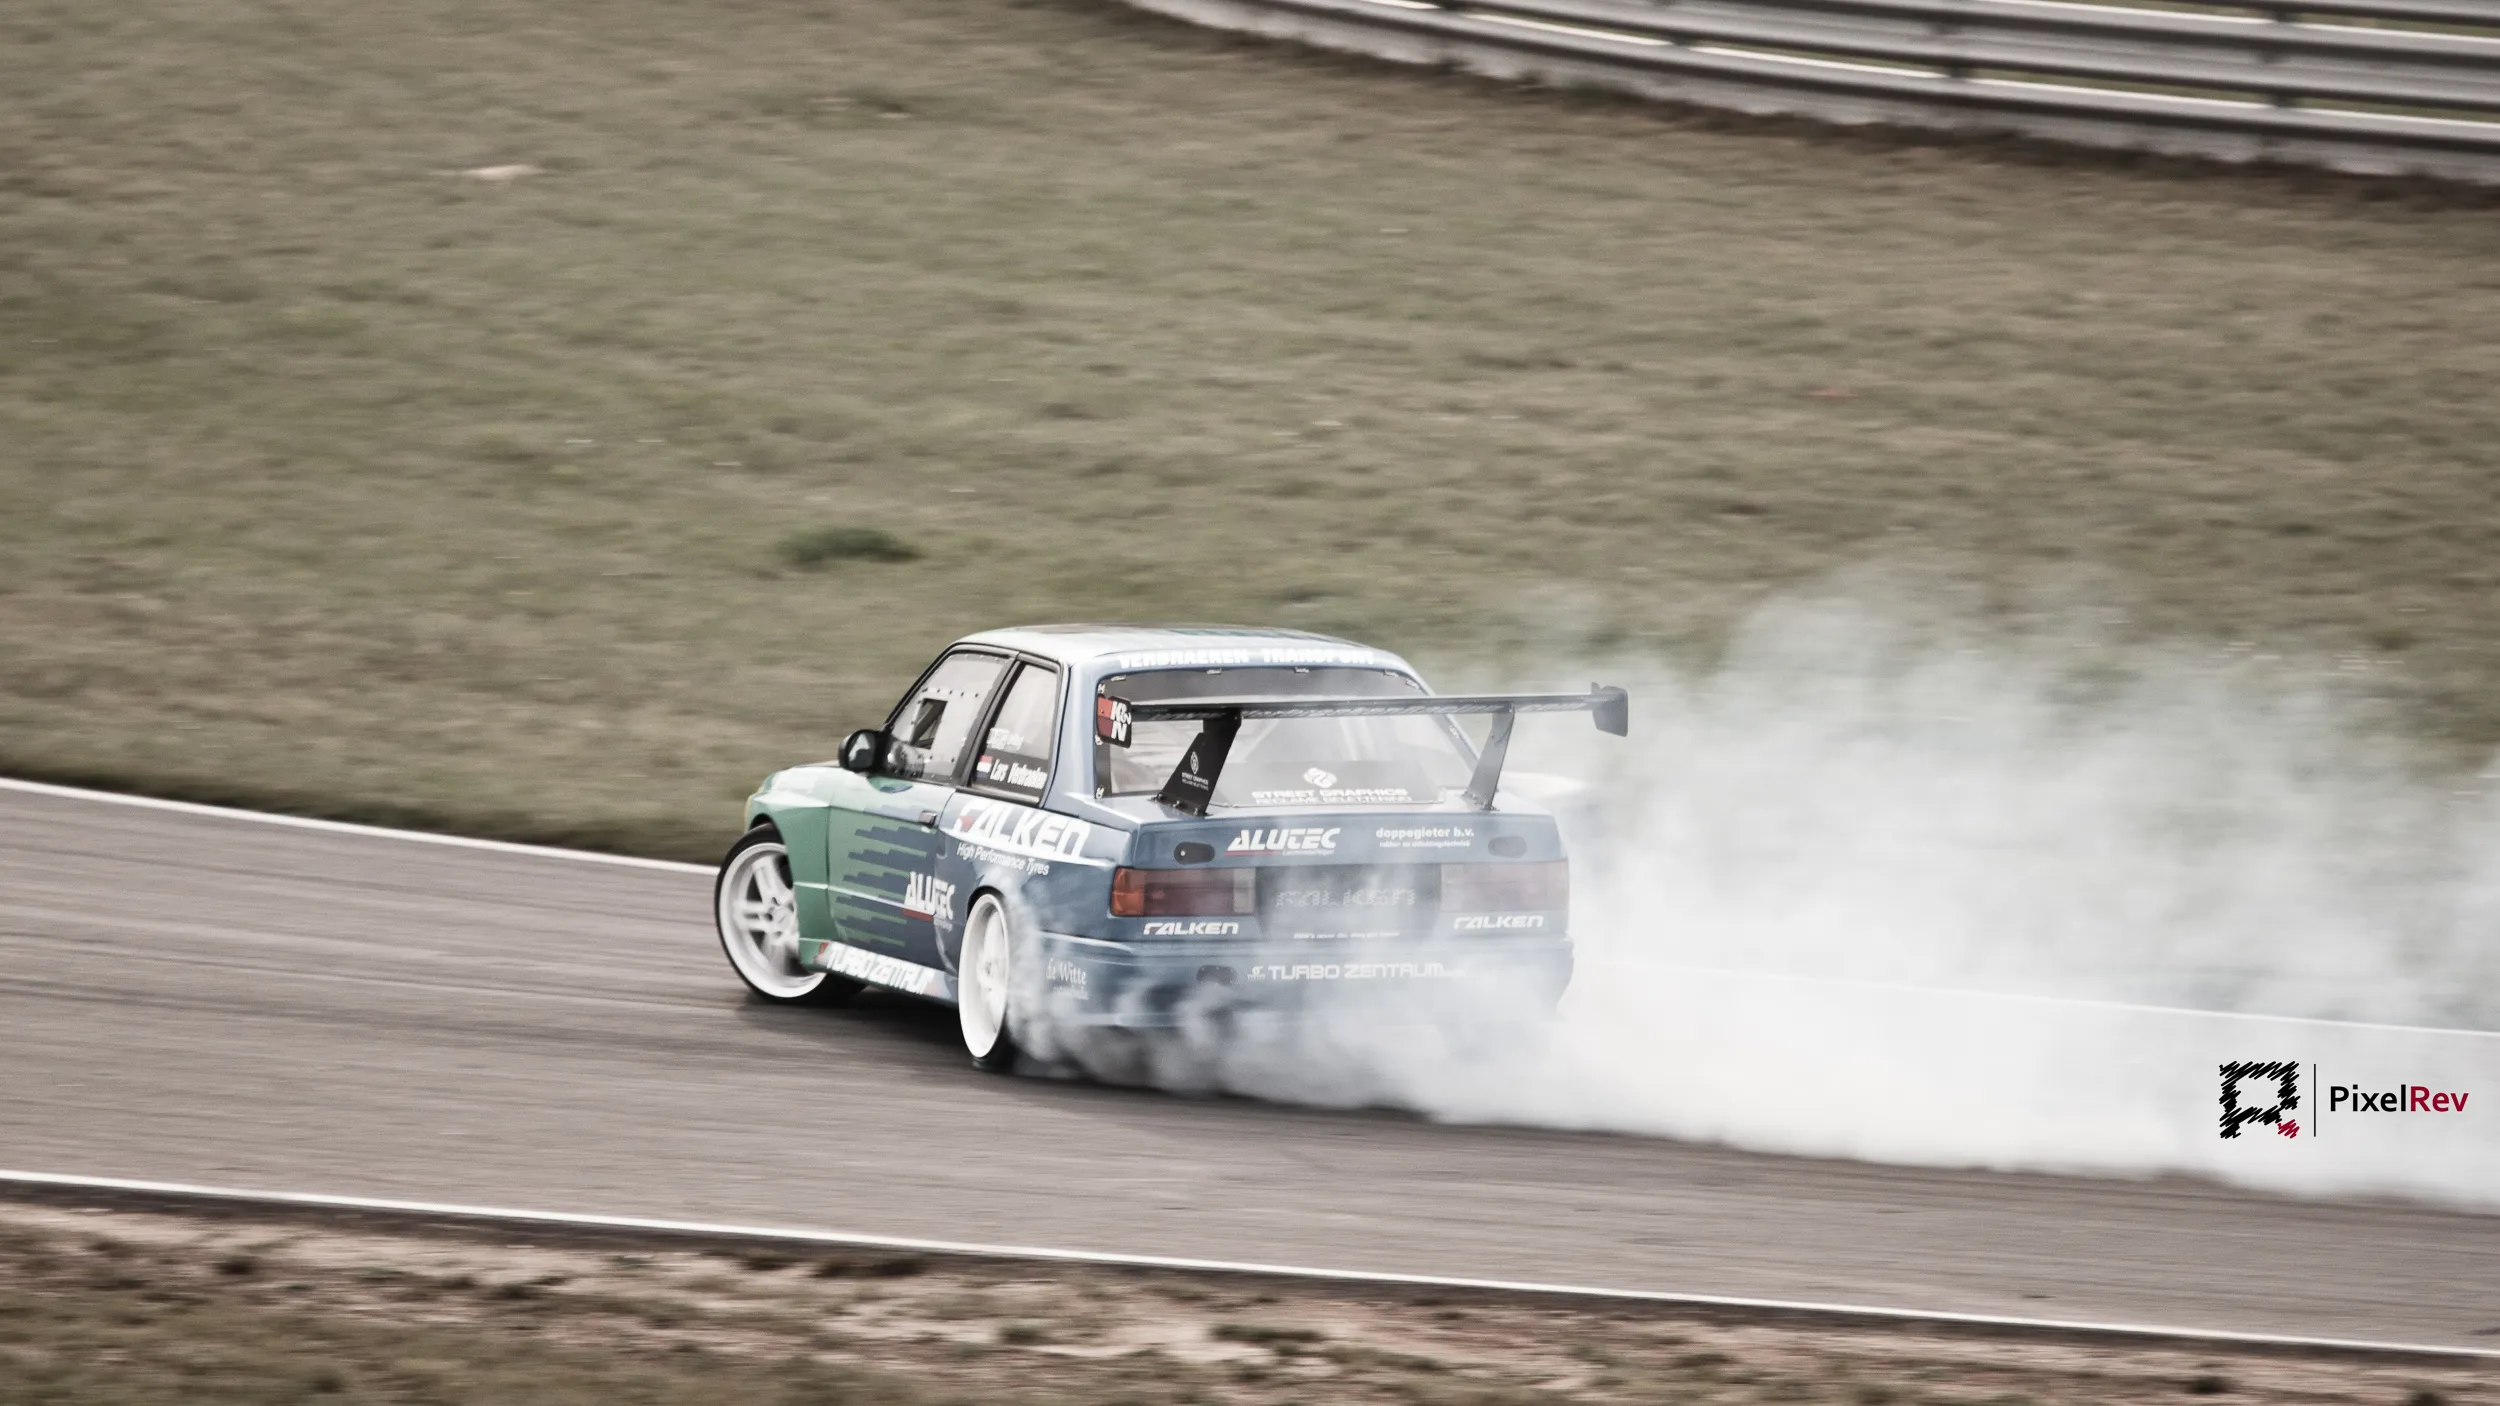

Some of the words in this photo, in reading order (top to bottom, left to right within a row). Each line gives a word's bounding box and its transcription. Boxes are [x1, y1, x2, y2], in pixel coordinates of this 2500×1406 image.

[1261, 648, 1374, 665] TRANSPORT
[1252, 789, 1315, 798] STREET
[1319, 788, 1408, 796] GRAPHICS
[953, 799, 1091, 858] FALKEN
[1227, 827, 1341, 851] ALUTEC
[956, 841, 975, 861] High
[974, 846, 1027, 870] Performance
[1026, 857, 1050, 876] Tyres
[903, 871, 956, 920] ALUTEC
[1143, 922, 1239, 936] FALKEN
[1453, 914, 1545, 930] FALKEN
[827, 941, 877, 980] TURBO
[1267, 964, 1340, 981] TURBO
[1343, 962, 1444, 980] ZENTRUM
[1059, 961, 1088, 985] Witte
